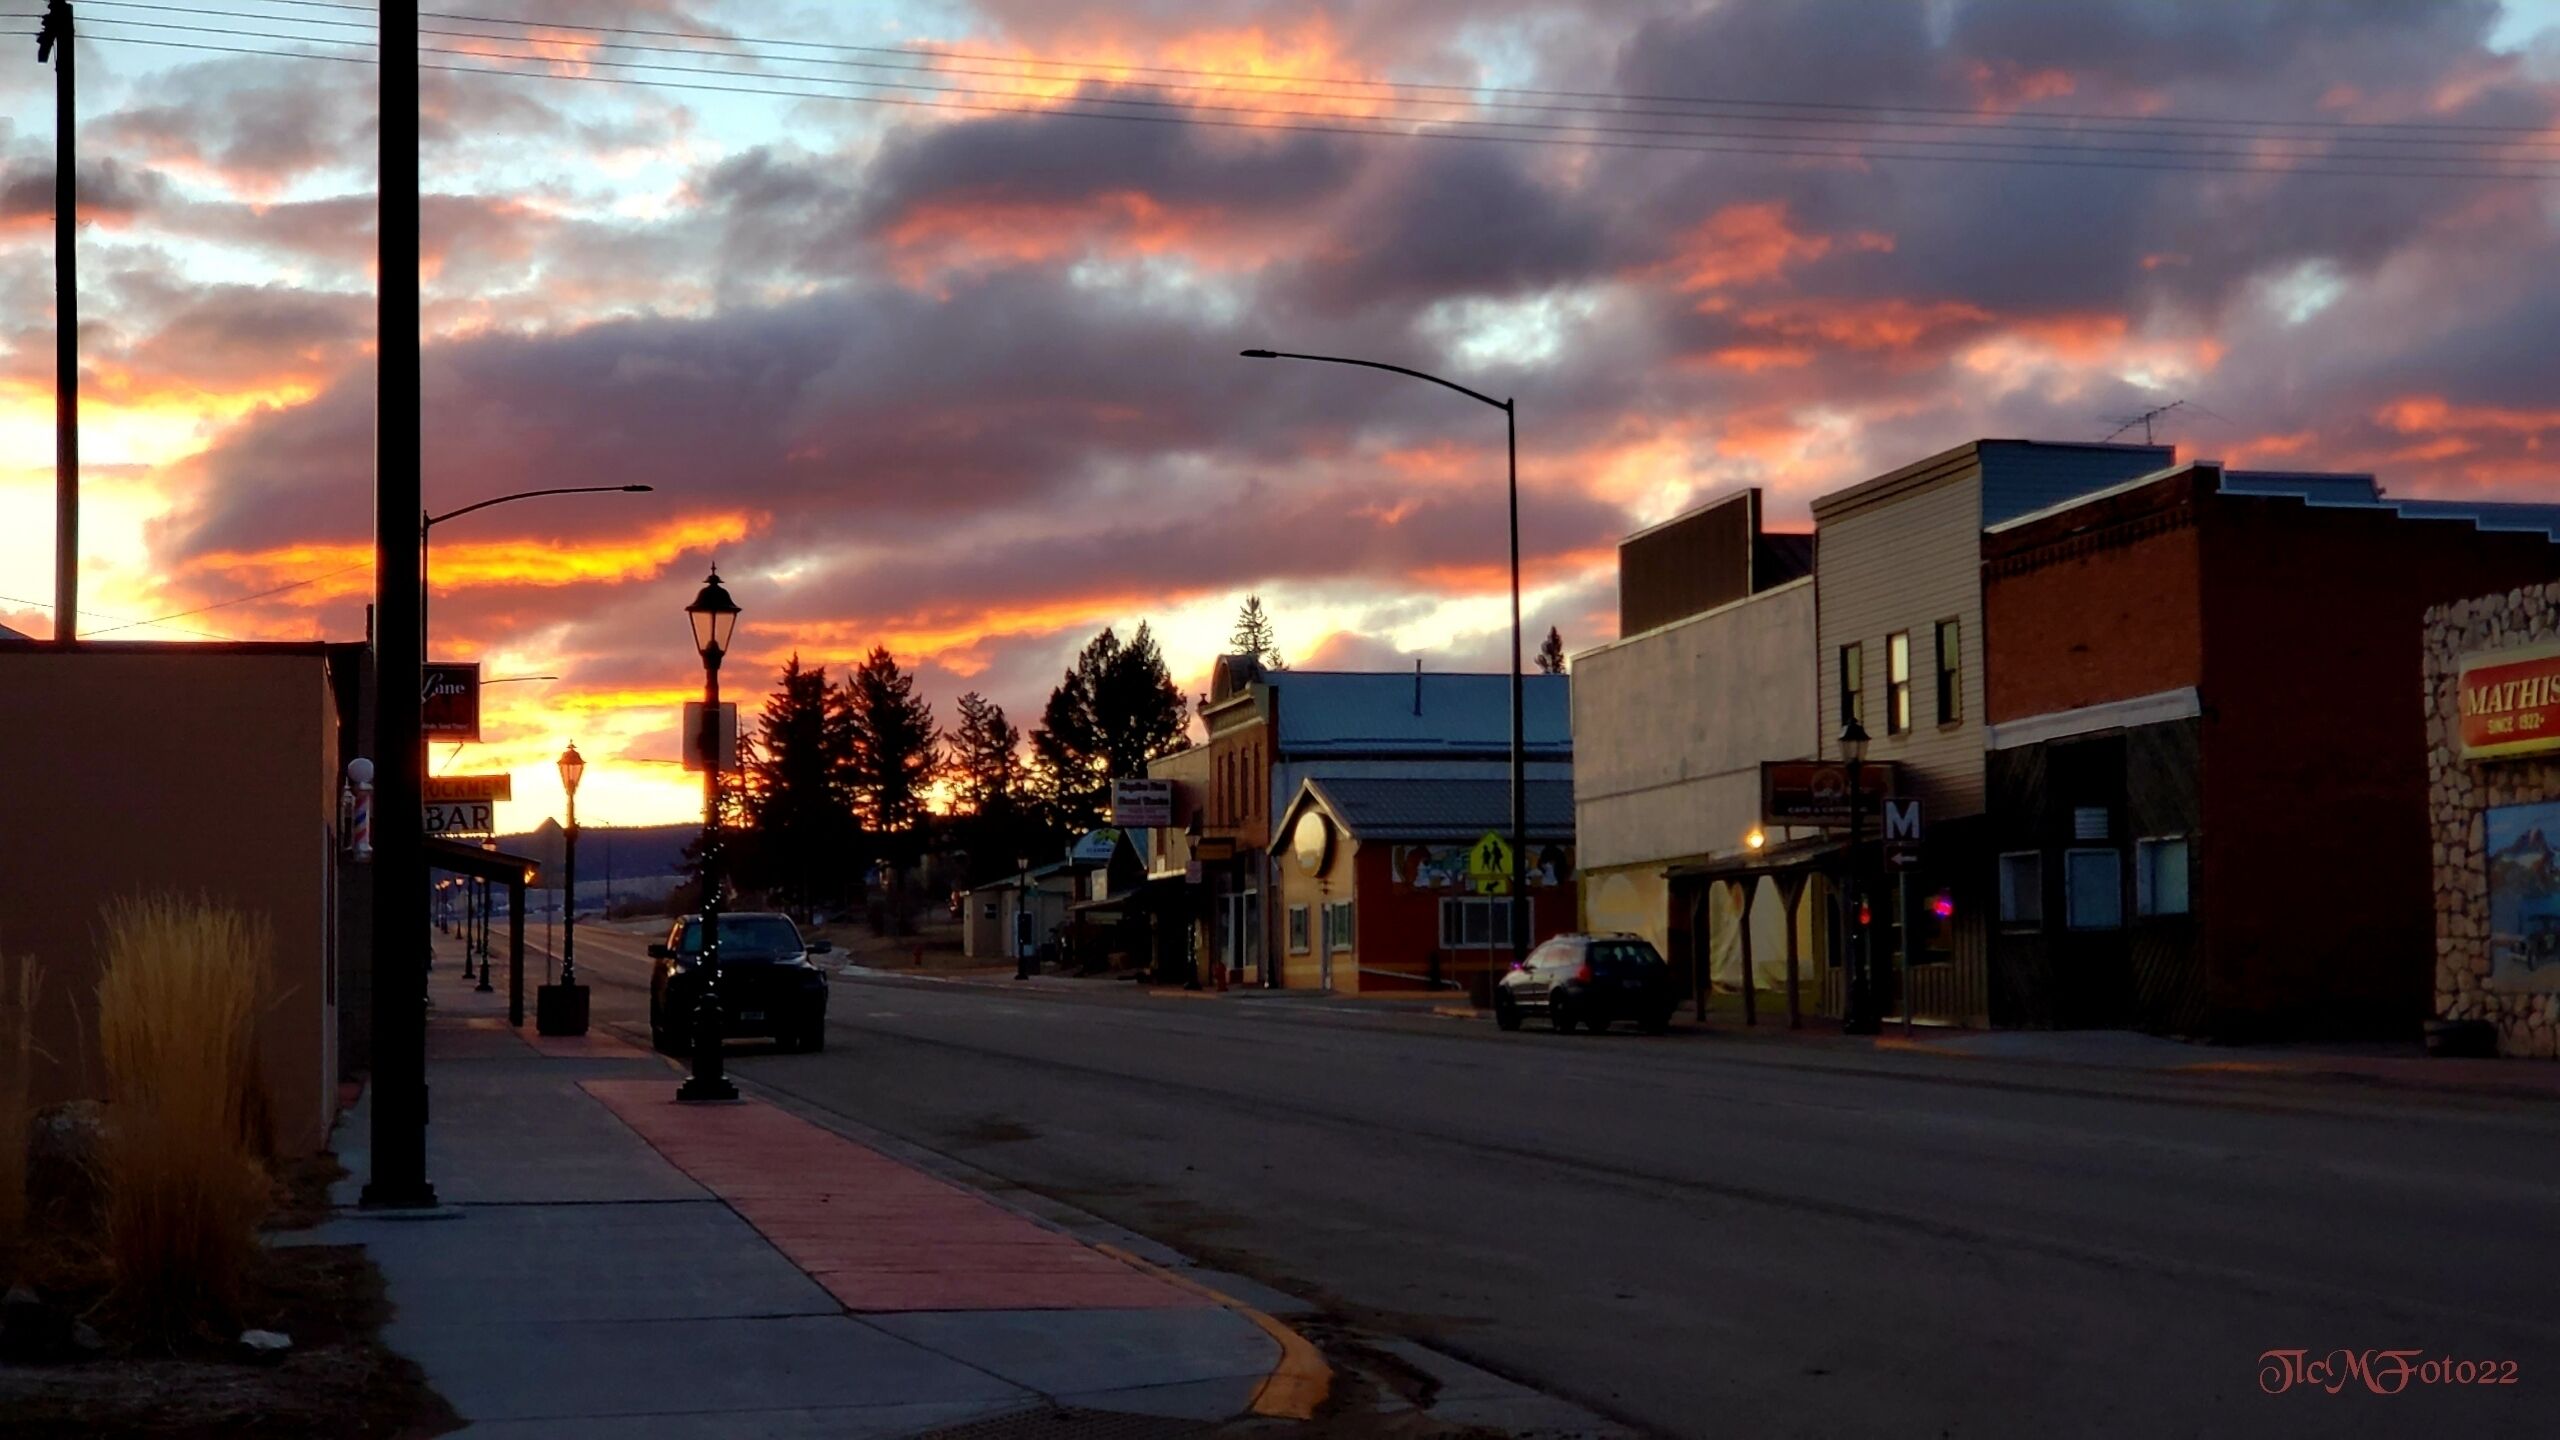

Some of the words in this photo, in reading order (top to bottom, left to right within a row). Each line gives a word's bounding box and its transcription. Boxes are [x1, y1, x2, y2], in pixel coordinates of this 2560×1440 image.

[424, 780, 508, 799] OCKMEN
[425, 806, 491, 832] BAR
[1885, 800, 1921, 840] M
